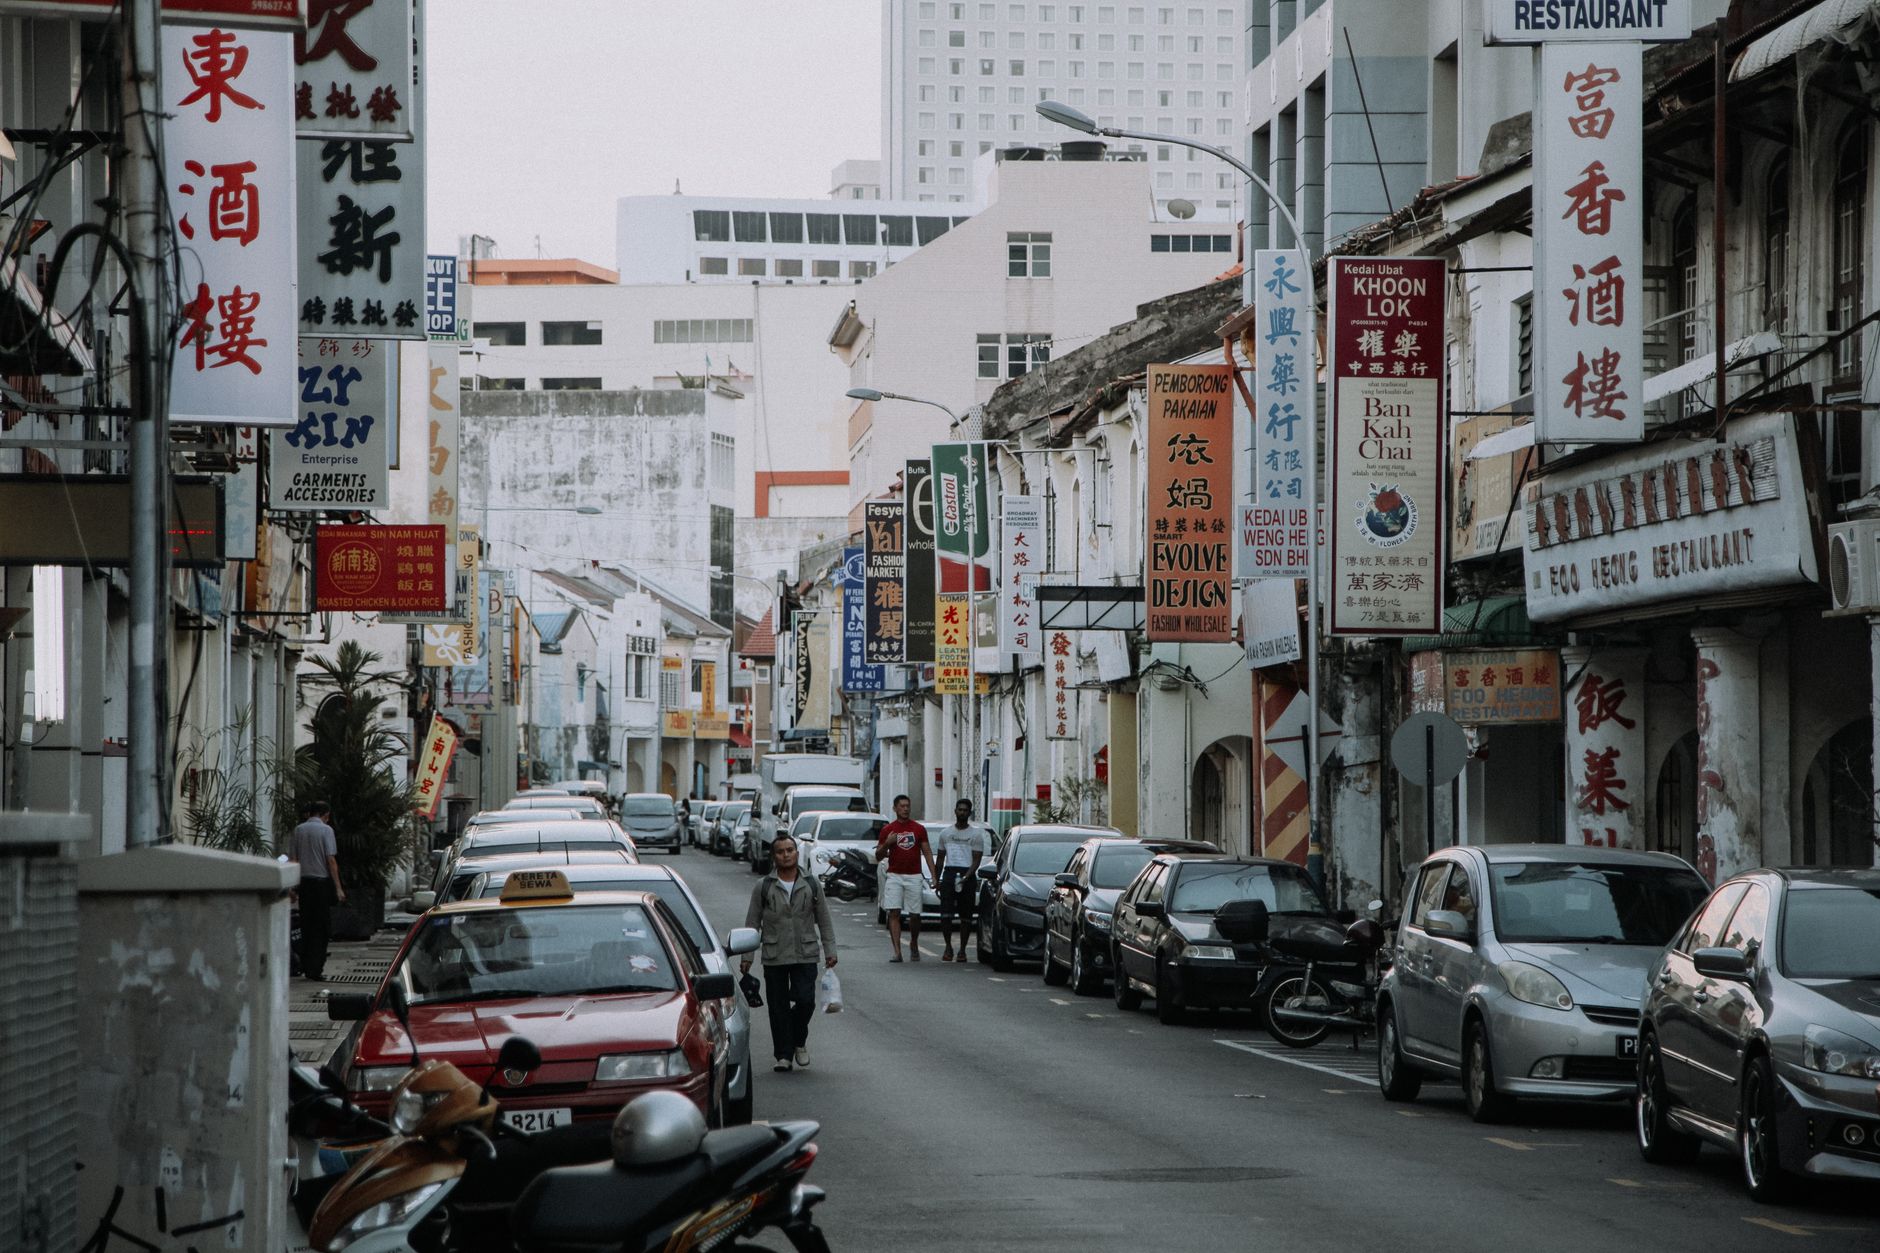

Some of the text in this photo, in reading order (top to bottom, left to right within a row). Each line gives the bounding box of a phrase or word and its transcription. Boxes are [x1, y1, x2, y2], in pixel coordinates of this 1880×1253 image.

[1515, 0, 1667, 30] RESTAURANT
[1562, 63, 1628, 422] 富香酒樓
[1344, 263, 1404, 276] Kedai Ubat
[1353, 278, 1427, 297] KHOON
[301, 295, 420, 328] 時裝批發
[1366, 298, 1412, 318] LOK
[1264, 255, 1302, 442] 永興藥行
[1348, 361, 1429, 377] 中西藥行
[1154, 374, 1228, 393] PEMBORONG
[1163, 399, 1217, 419] PAKAIAN
[1364, 397, 1411, 417] Ban
[1362, 418, 1411, 439] Kah
[1358, 439, 1412, 461] Chai
[302, 454, 358, 466] Enterprise
[1265, 450, 1303, 472] 有限
[908, 466, 927, 475] Butik
[293, 473, 367, 488] GARMENTS
[1265, 479, 1302, 500] 公司
[284, 488, 376, 503] ACCESSORIES
[943, 478, 957, 521] Castrol
[868, 504, 904, 518] Fesye
[1244, 509, 1325, 527] KEDAI UBT
[370, 530, 387, 539] SIN
[389, 530, 411, 539] NAM
[414, 530, 440, 539] HUAT
[1244, 529, 1325, 547] WENG HEG
[332, 547, 376, 573] 新南發
[1152, 543, 1227, 572] EVOLVE
[1255, 549, 1309, 566] SDN BH
[1347, 573, 1425, 591] 萬家濟
[317, 598, 354, 607] ROASTED
[355, 597, 389, 607] CHICKEN
[399, 597, 419, 607] DUCK
[422, 597, 440, 607] RICE
[1152, 579, 1227, 608] DESIGN
[1152, 615, 1227, 632] FASHION WHOLESALE
[463, 613, 474, 660] FASHIO
[1450, 688, 1486, 705] FOO
[512, 871, 558, 881] KERETA
[520, 880, 552, 889] SEWA
